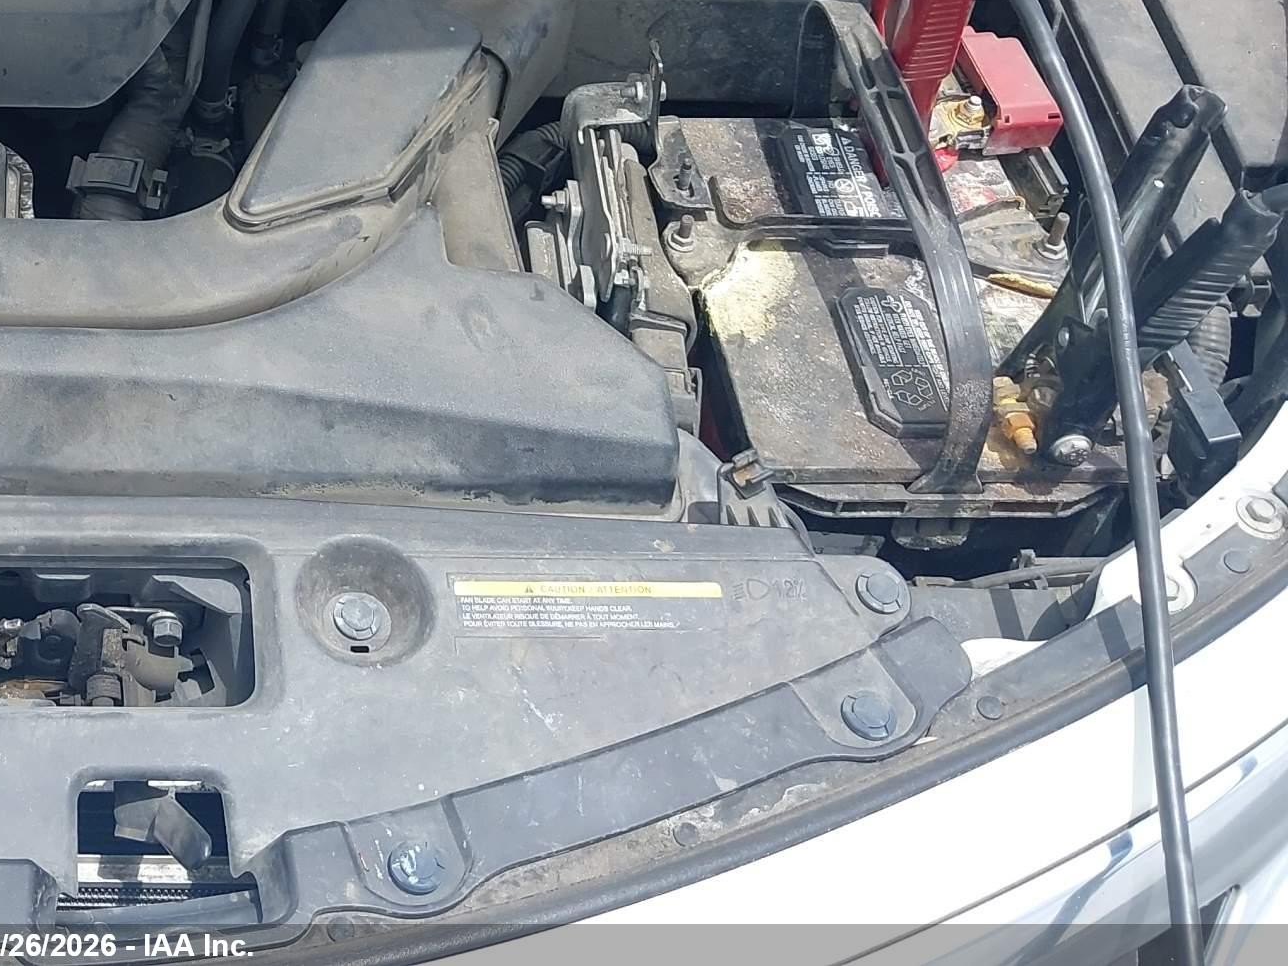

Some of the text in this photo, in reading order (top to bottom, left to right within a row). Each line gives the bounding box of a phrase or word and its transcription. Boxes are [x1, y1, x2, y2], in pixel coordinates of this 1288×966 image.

[843, 146, 867, 184] DANGER
[540, 585, 585, 594] CAUTION
[597, 585, 652, 594] ATTENTION
